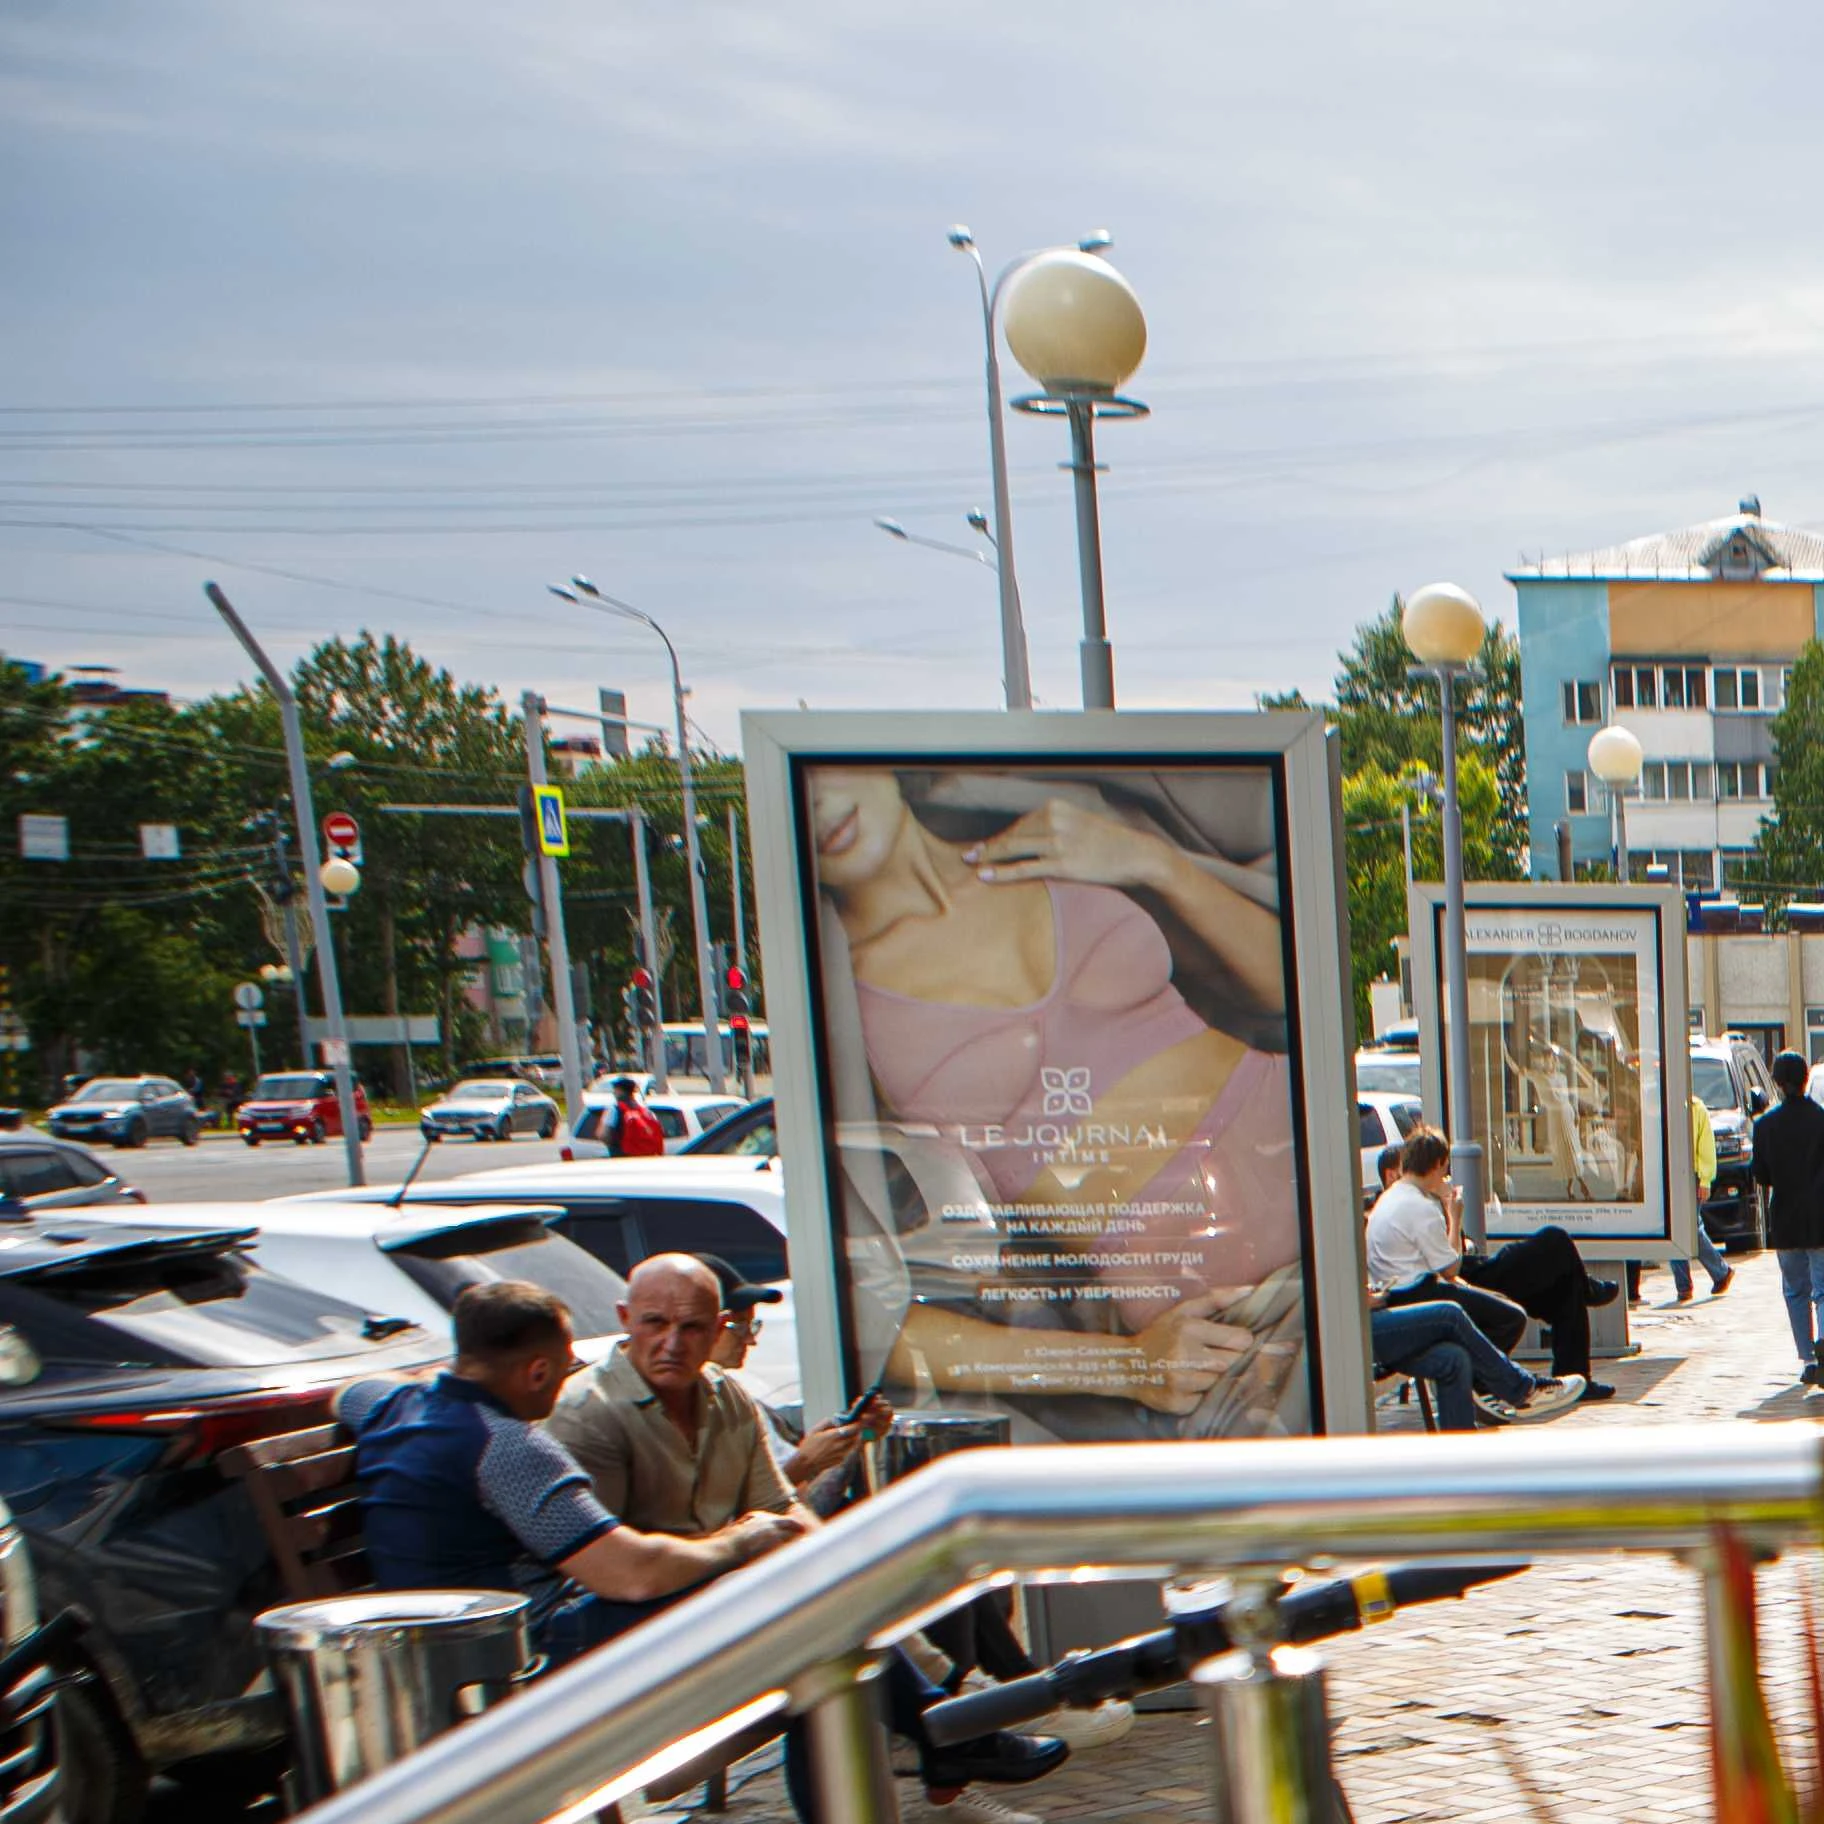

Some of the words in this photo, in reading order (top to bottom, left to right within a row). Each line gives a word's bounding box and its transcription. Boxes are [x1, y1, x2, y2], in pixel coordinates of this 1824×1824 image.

[1564, 927, 1637, 941] BOGDANOV
[959, 1124, 1005, 1147] LE
[1013, 1123, 1177, 1146] JOURNAL
[1033, 1150, 1110, 1163] INTIME
[942, 1202, 1104, 1218] ОЗДАВЛИВАЮЩАЯ
[1108, 1202, 1205, 1217] ПОДДЕРЖКА
[1006, 1220, 1028, 1234] НА
[1030, 1218, 1101, 1234] КАЖДЫЙ
[1105, 1219, 1146, 1233] ДЕНЬ
[952, 1253, 1050, 1268] СОХРАНЕНИЕ
[1054, 1252, 1151, 1268] МОЛОДОСТИ
[1154, 1251, 1203, 1267] ГРУДИ
[981, 1286, 1057, 1300] ЛЕГКОСТЬ
[1060, 1286, 1072, 1299] И
[1075, 1285, 1182, 1299] УВЕРЕННОСТЬ
